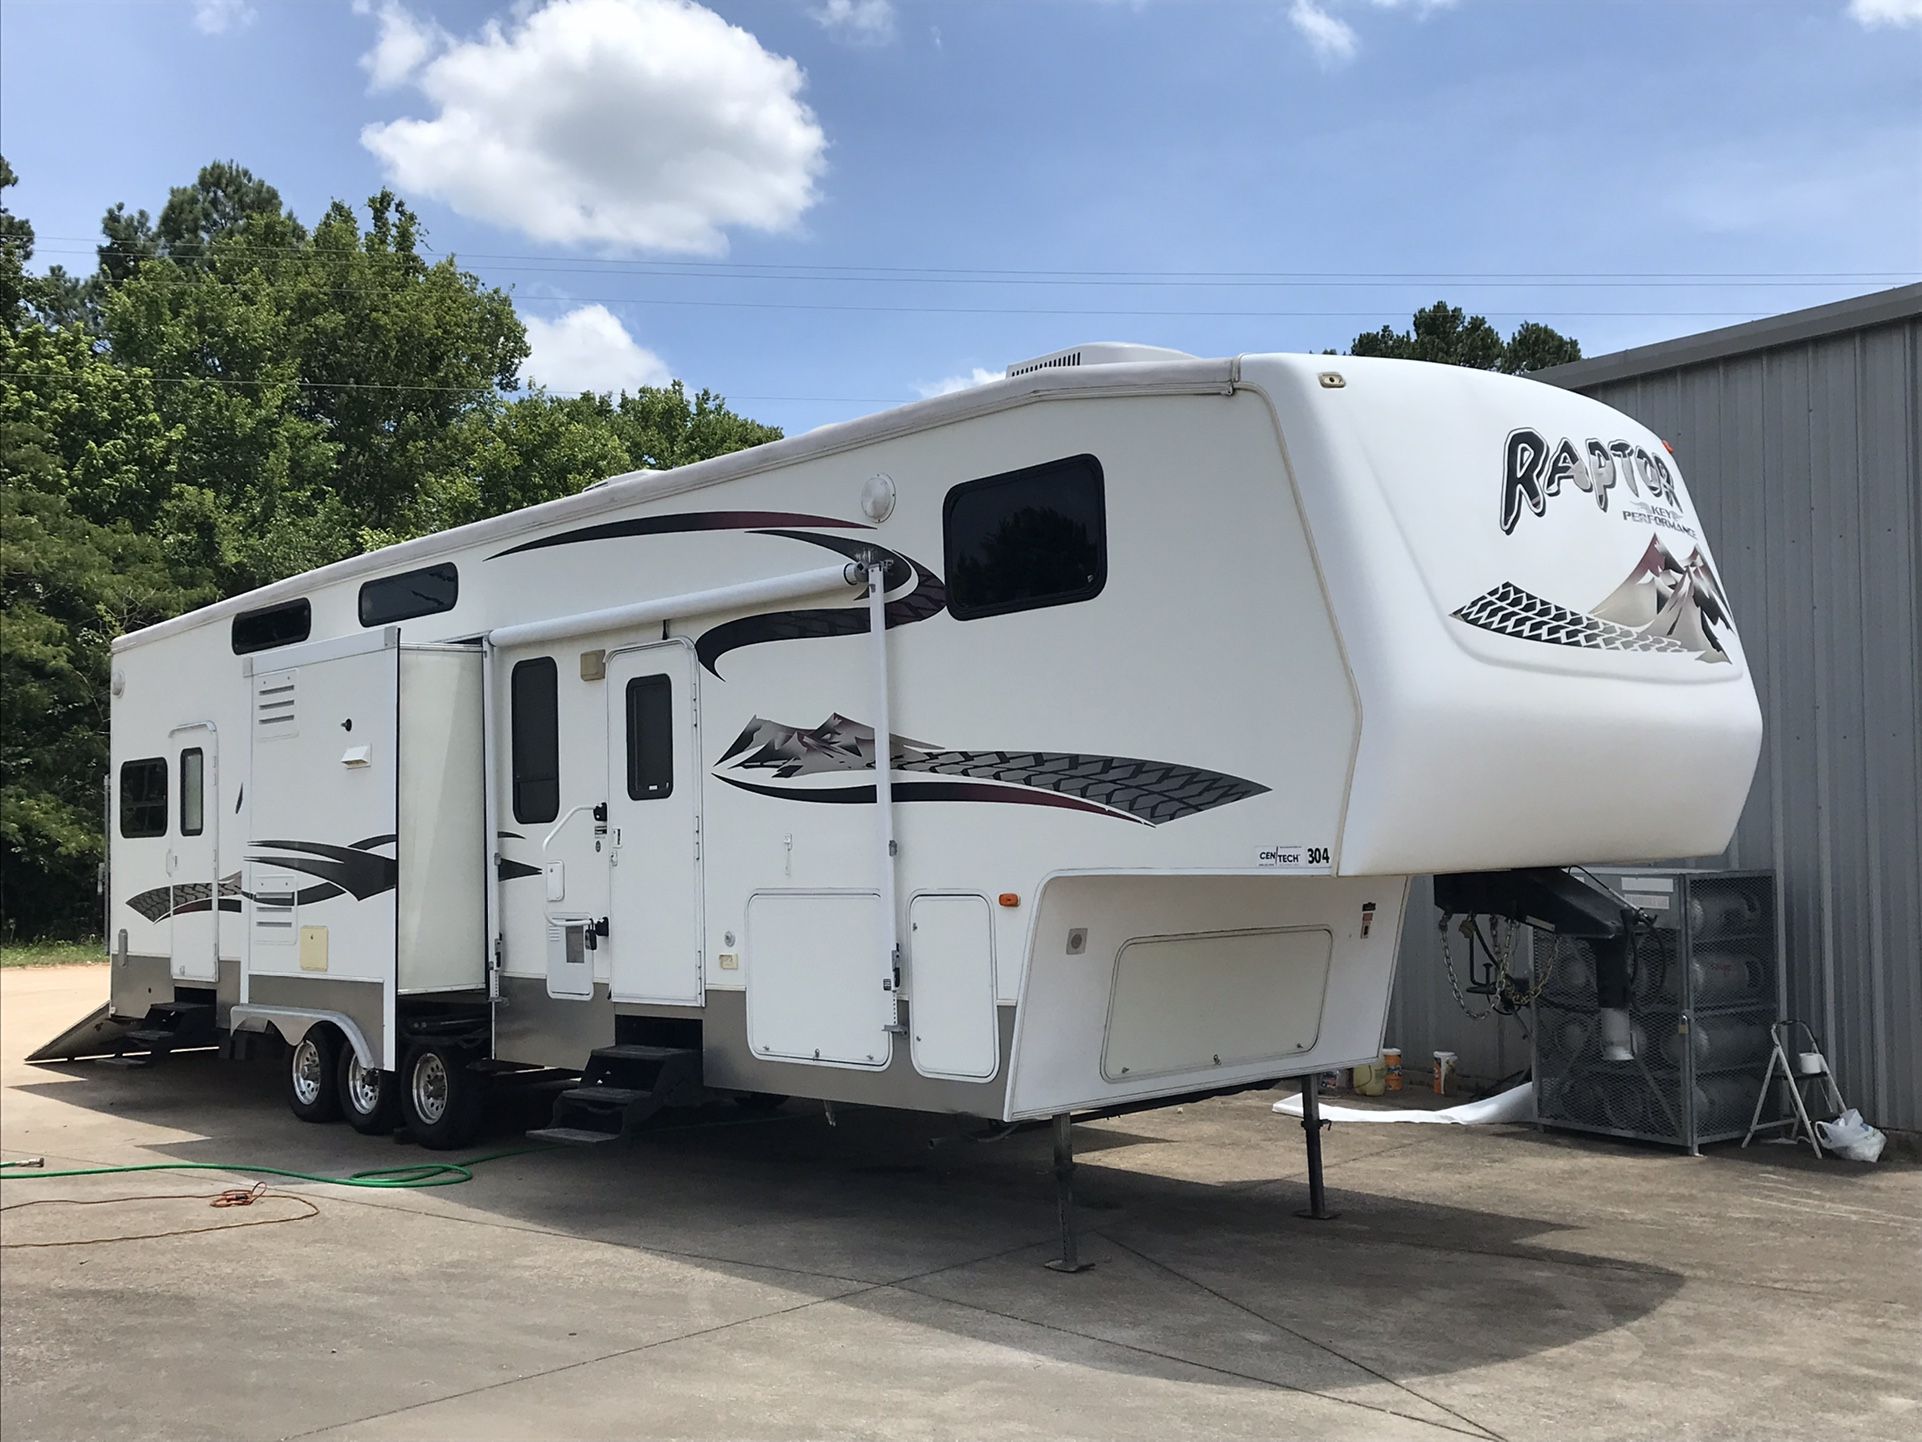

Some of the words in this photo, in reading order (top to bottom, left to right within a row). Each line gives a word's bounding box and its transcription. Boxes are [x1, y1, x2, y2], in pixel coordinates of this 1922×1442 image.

[1500, 427, 1684, 536] RAPTOR
[1651, 505, 1671, 519] KEY
[1622, 510, 1698, 540] PERFORMANCE
[1259, 851, 1276, 860] CEN
[1277, 854, 1299, 863] TECH
[1307, 847, 1330, 864] 304
